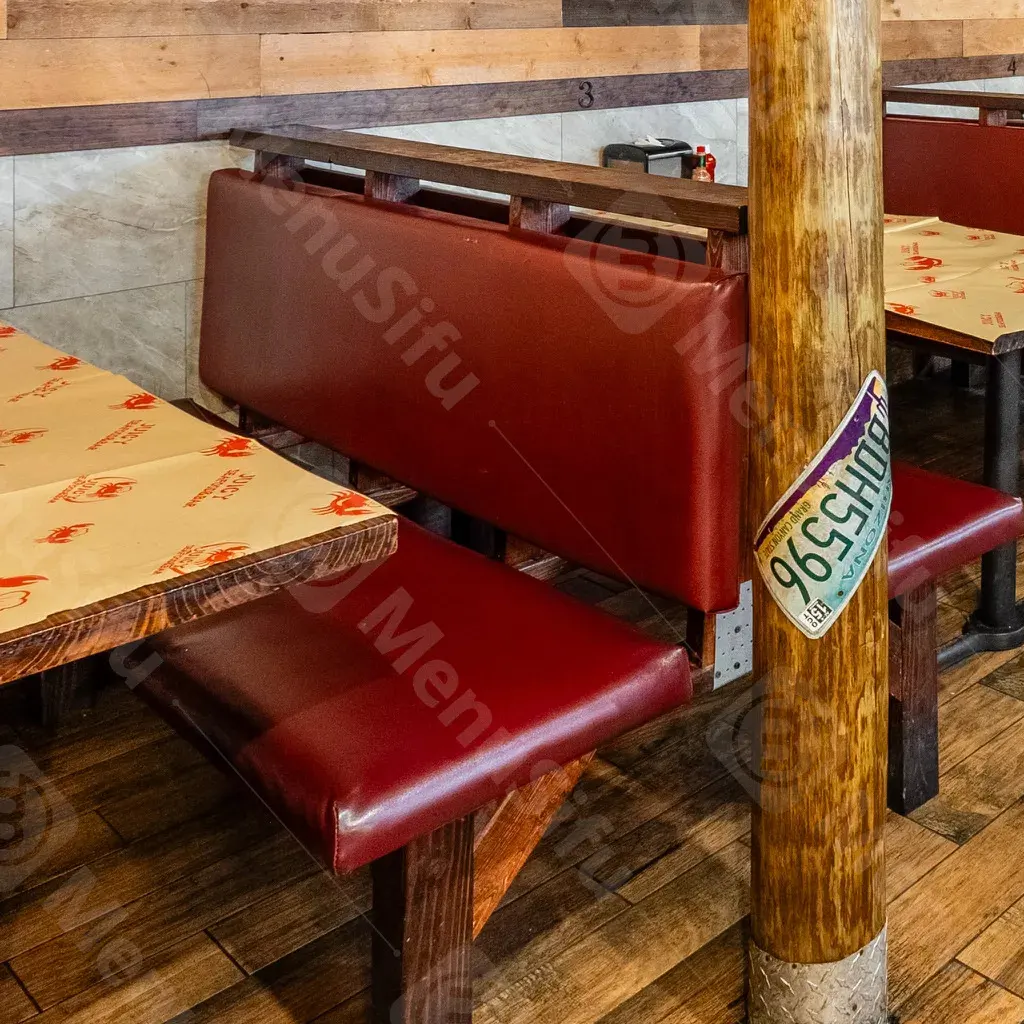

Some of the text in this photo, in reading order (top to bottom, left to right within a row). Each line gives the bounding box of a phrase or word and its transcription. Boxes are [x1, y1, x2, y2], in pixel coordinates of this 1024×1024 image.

[1007, 56, 1017, 76] 4
[578, 81, 595, 109] 3
[211, 474, 257, 501] JUICY
[803, 613, 818, 628] OCT
[809, 600, 827, 622] 15
